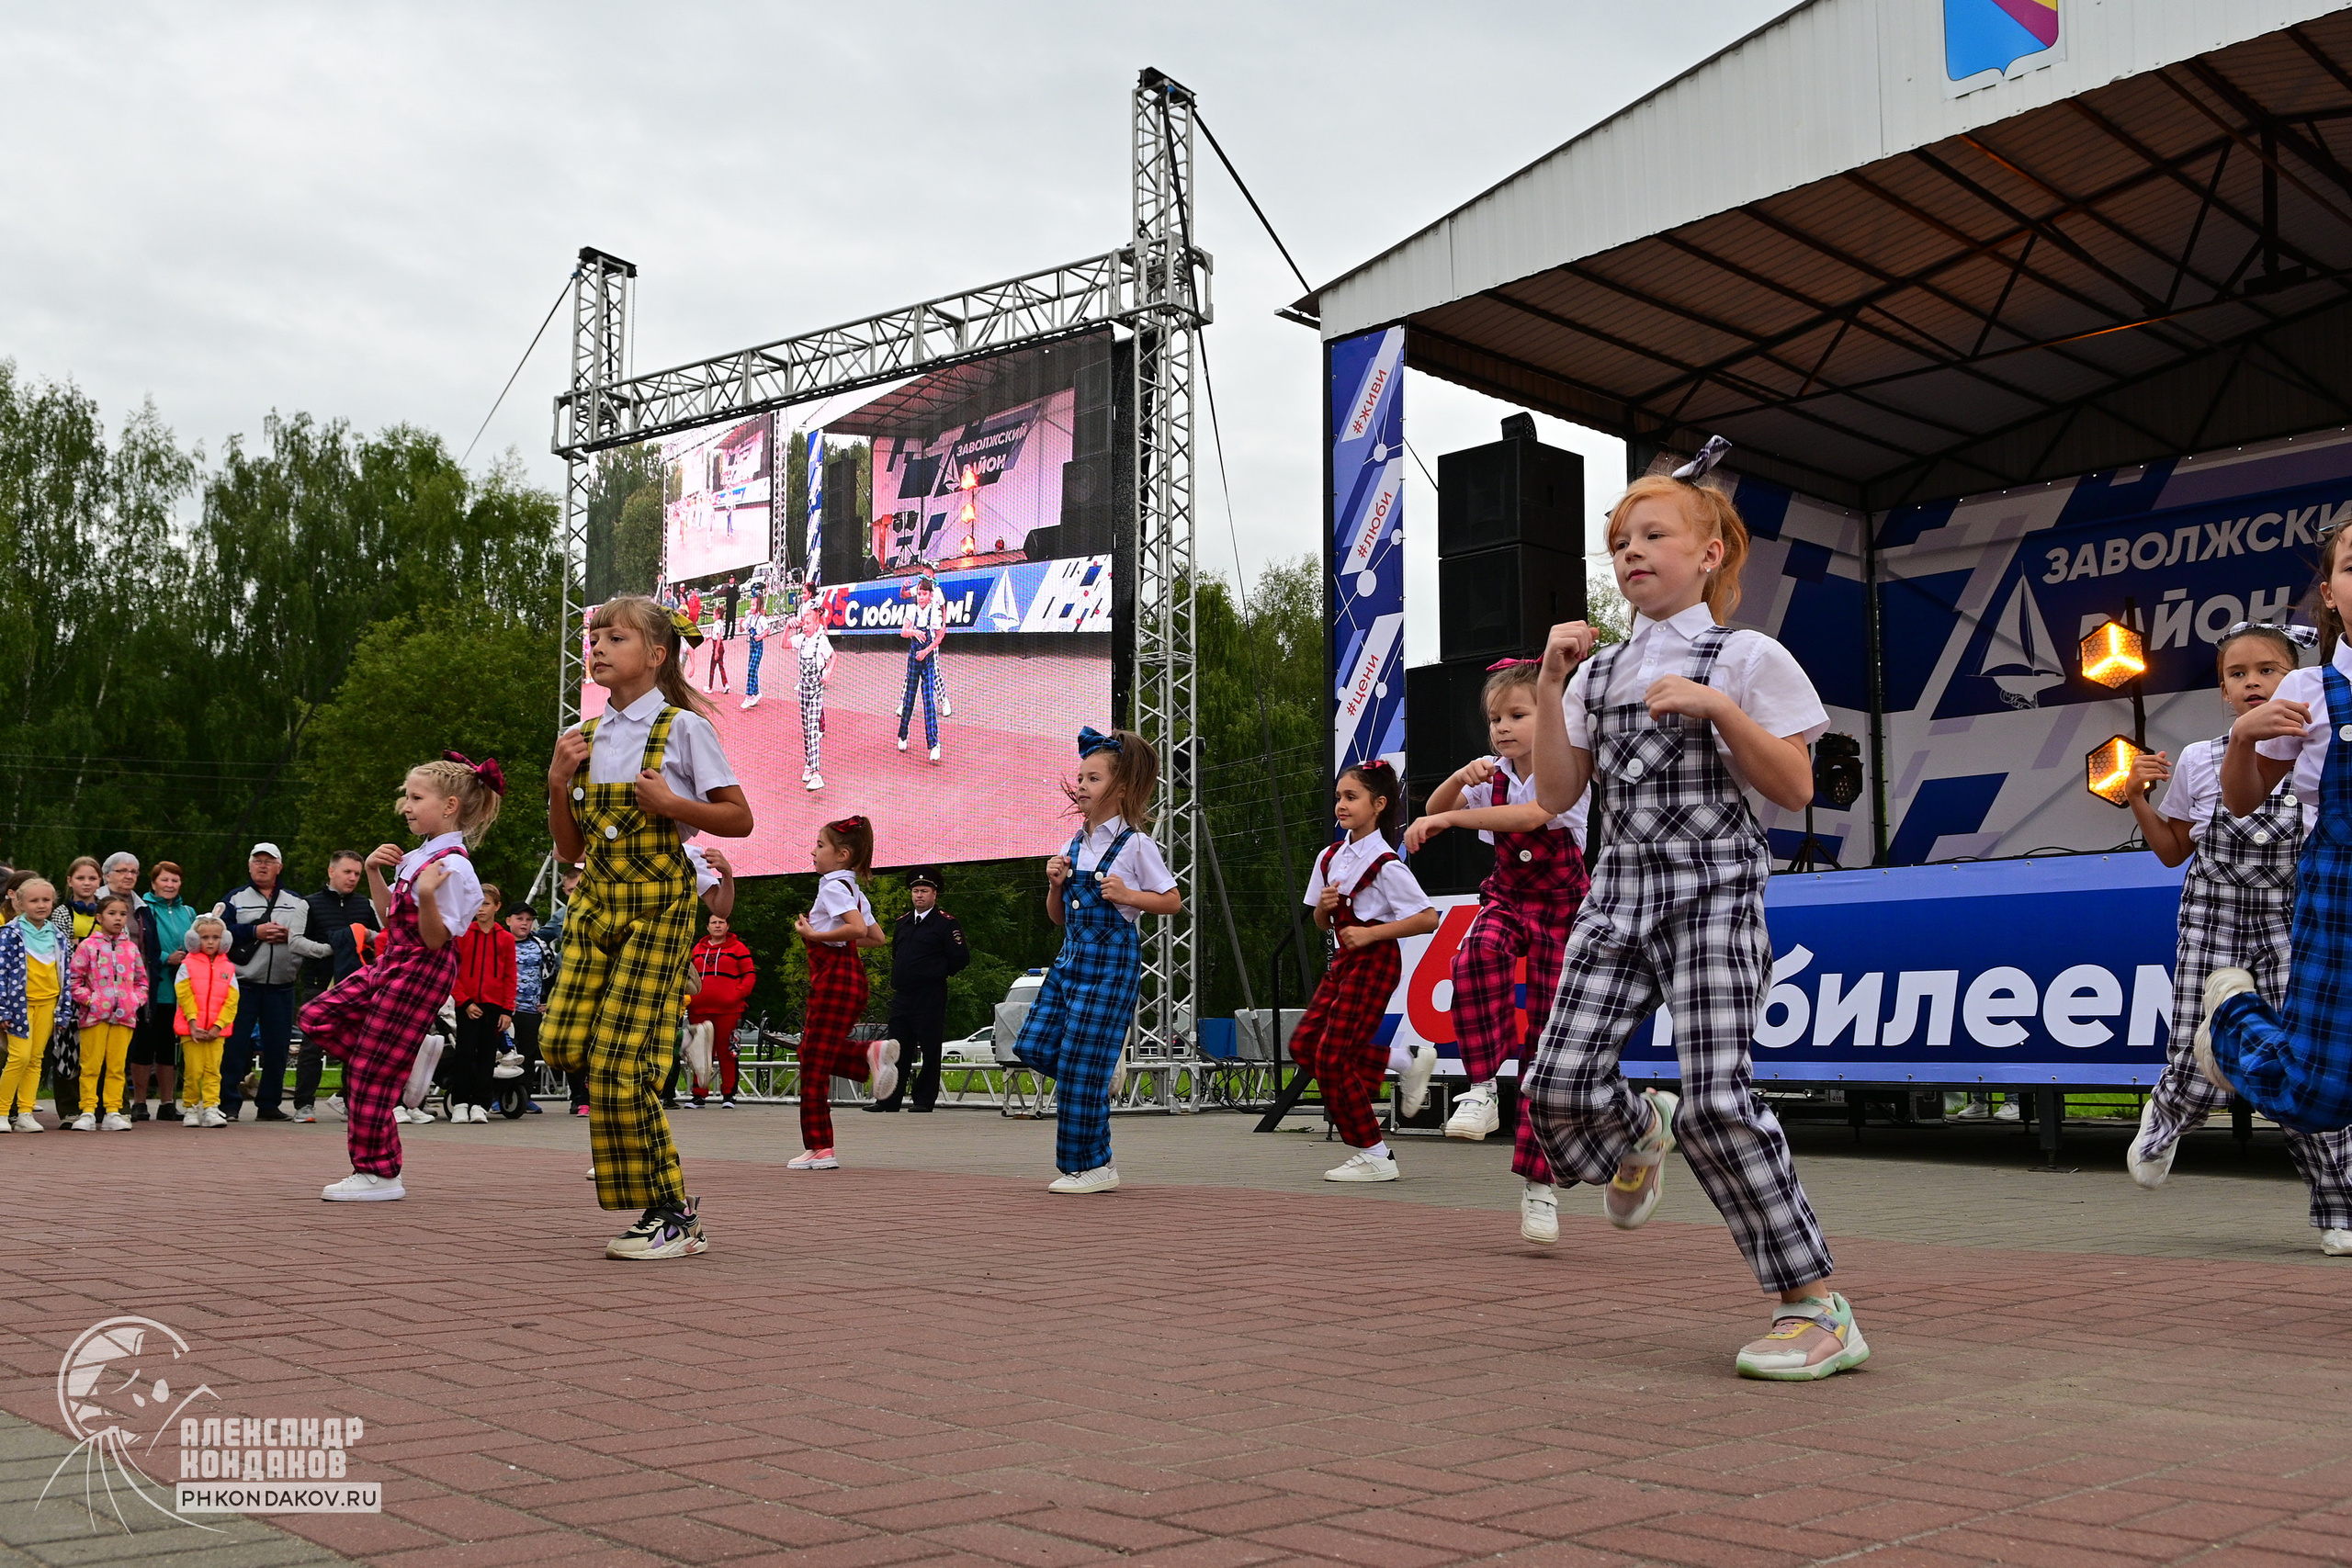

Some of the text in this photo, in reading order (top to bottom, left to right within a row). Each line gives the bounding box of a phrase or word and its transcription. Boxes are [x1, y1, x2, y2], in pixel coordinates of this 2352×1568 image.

[1352, 369, 1387, 434] #живи
[956, 423, 1028, 457] ЗАВОЛЖСКИЙ
[1357, 491, 1392, 558] #люби
[2076, 585, 2290, 660] ЙОН
[1346, 654, 1379, 716] #цени
